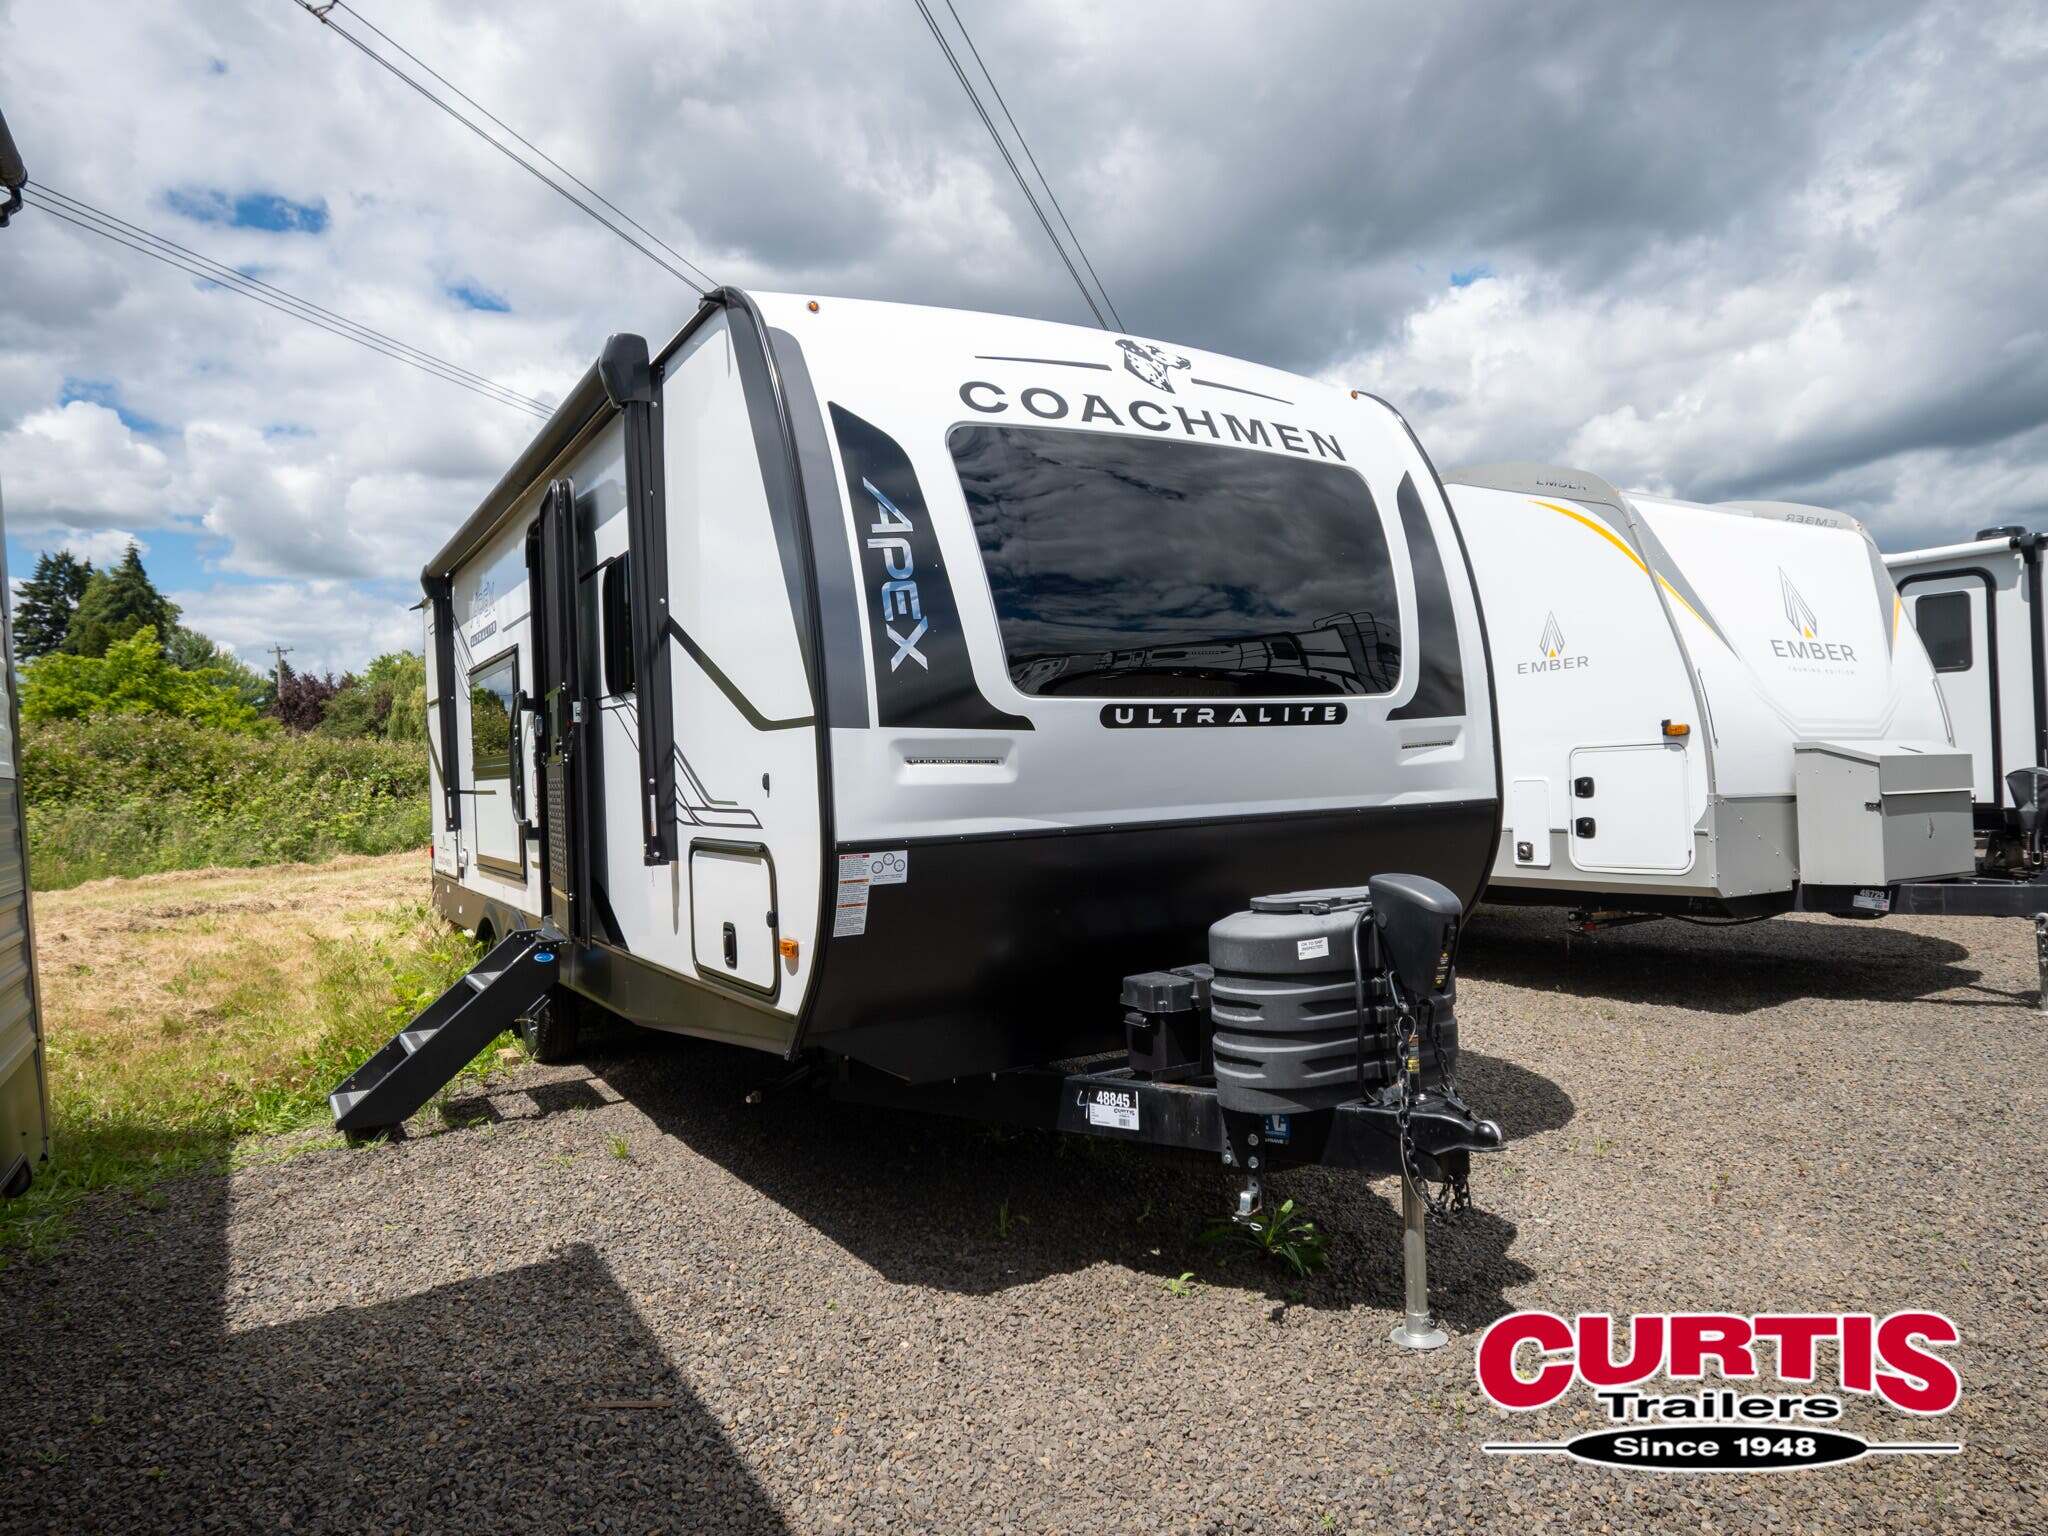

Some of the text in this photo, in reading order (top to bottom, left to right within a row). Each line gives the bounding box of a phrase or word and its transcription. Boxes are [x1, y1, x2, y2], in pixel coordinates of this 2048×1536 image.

[958, 381, 1346, 461] COACHMEN
[862, 477, 928, 673] APEX
[1770, 640, 1857, 661] EMBER
[1517, 655, 1589, 674] EMBER
[1115, 706, 1339, 724] ULTRALITE
[1096, 1090, 1130, 1108] 48845
